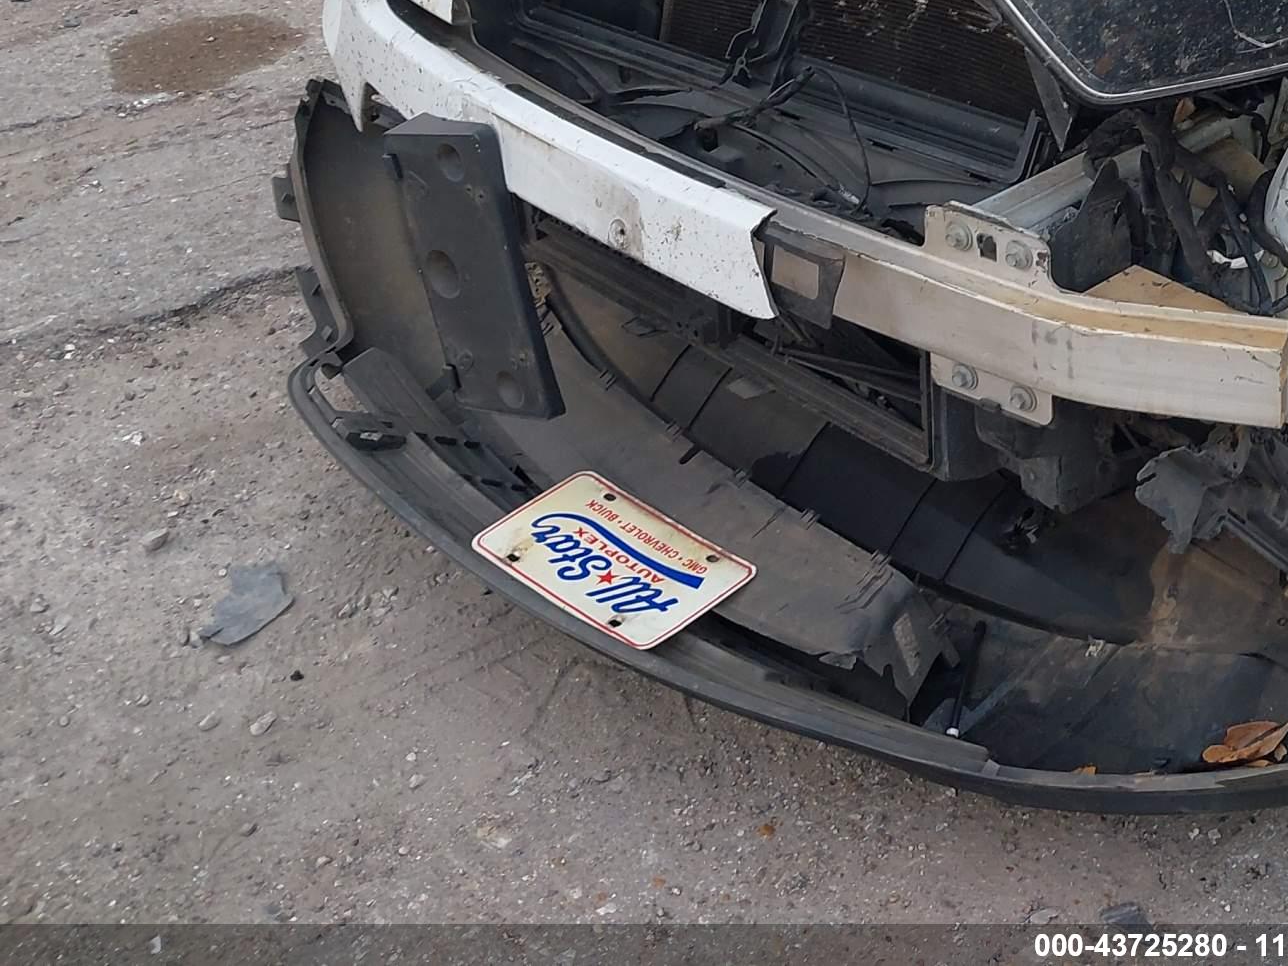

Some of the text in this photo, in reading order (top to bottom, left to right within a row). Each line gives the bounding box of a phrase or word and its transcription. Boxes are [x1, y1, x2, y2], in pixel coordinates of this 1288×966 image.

[530, 523, 679, 614] All Star
[572, 526, 666, 584] AUTOPLEX
[584, 498, 708, 574] GMC CHEVROLET BUICK
